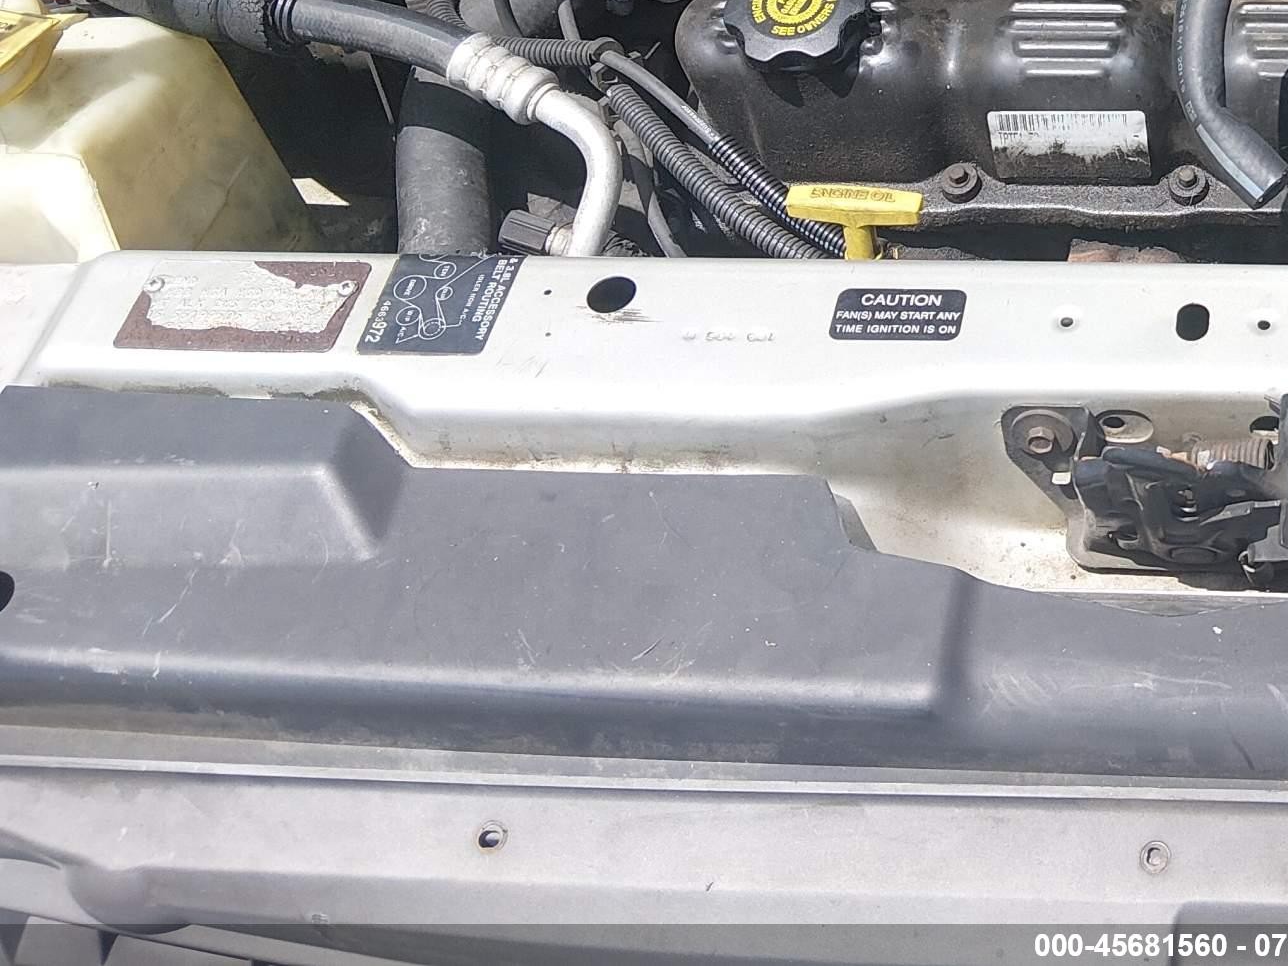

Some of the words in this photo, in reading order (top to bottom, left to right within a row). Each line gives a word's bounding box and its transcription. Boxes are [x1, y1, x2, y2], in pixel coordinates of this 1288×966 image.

[771, 25, 796, 36] SEE
[809, 187, 869, 201] ENGINE
[491, 259, 508, 280] BELT
[502, 265, 515, 284] 3.8L
[473, 274, 484, 296] IDLER
[472, 281, 494, 323] ROUTING
[861, 294, 943, 306] CAUTION
[475, 285, 507, 341] ACCESSORY
[836, 311, 873, 321] FAN(S)
[875, 311, 898, 320] MAY
[900, 311, 937, 321] START
[938, 312, 961, 321] ANY
[835, 324, 862, 333] TIME
[867, 324, 919, 334] IGNITION
[923, 325, 935, 334] IS
[938, 325, 957, 334] ON
